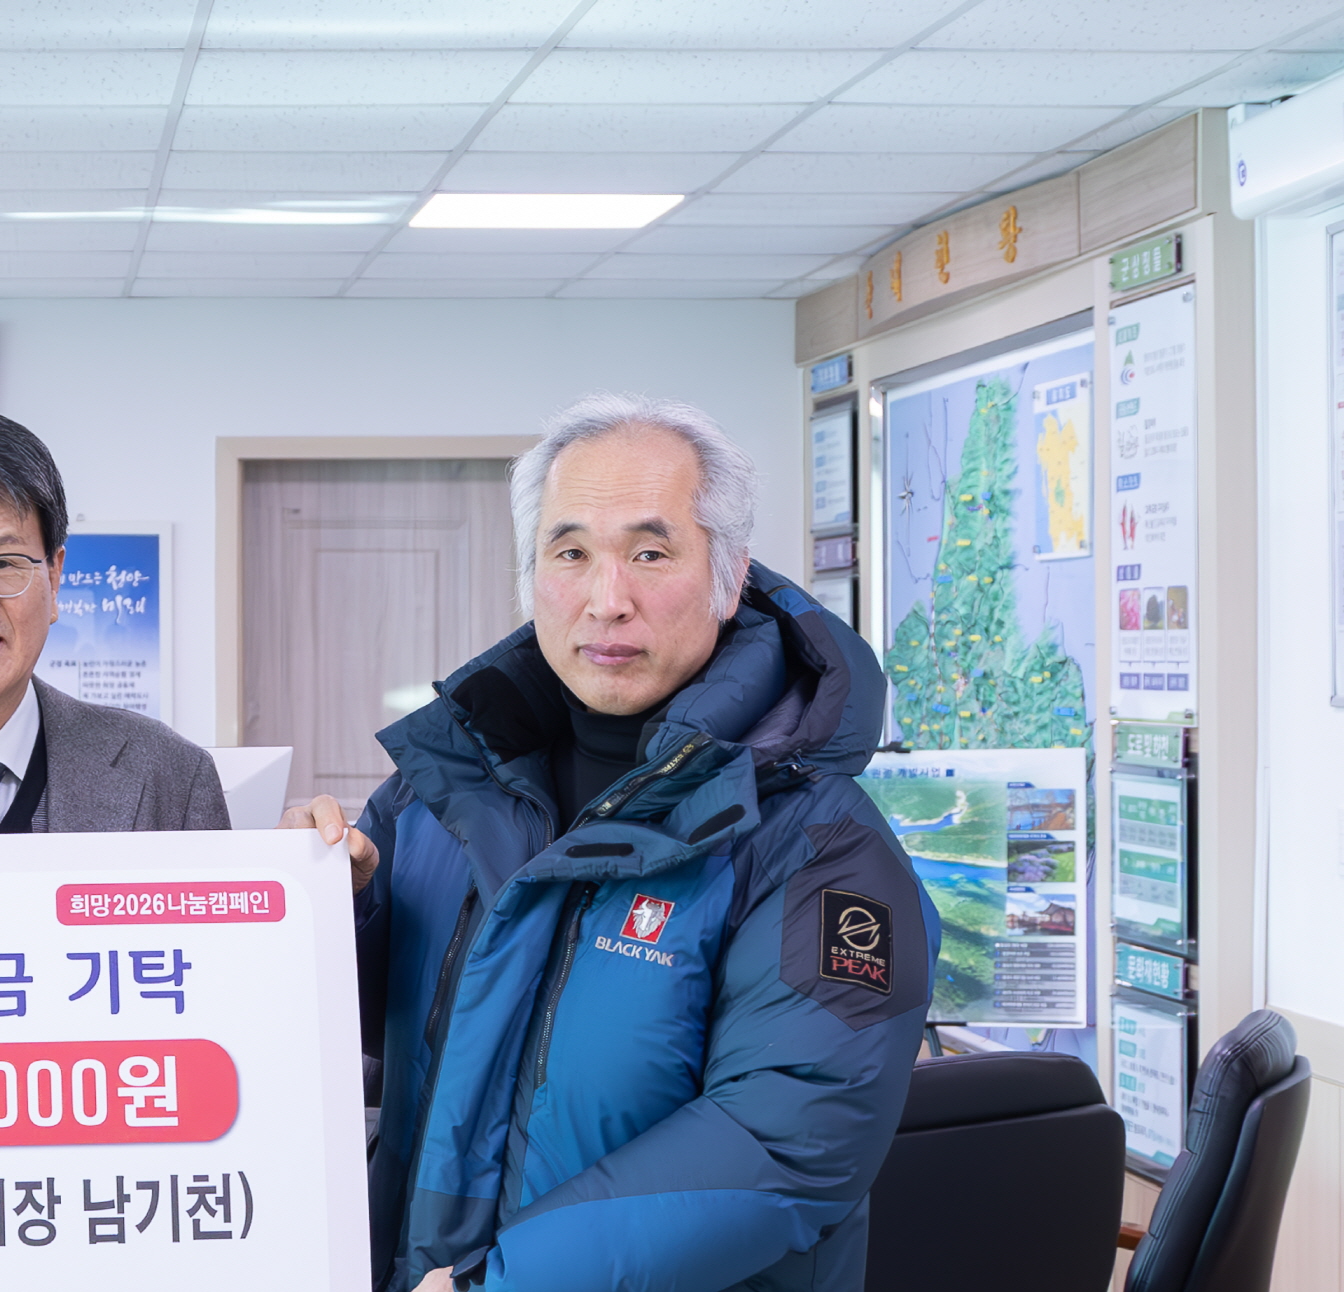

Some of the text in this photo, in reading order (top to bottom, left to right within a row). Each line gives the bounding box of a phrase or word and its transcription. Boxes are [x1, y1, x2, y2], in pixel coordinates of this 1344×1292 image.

[68, 570, 103, 586] 만드는
[106, 565, 149, 590] 청양
[829, 955, 887, 985] PEAK
[830, 946, 886, 967] EXTREME
[65, 948, 193, 1015] 기탁
[82, 1169, 256, 1246] 남기천)
